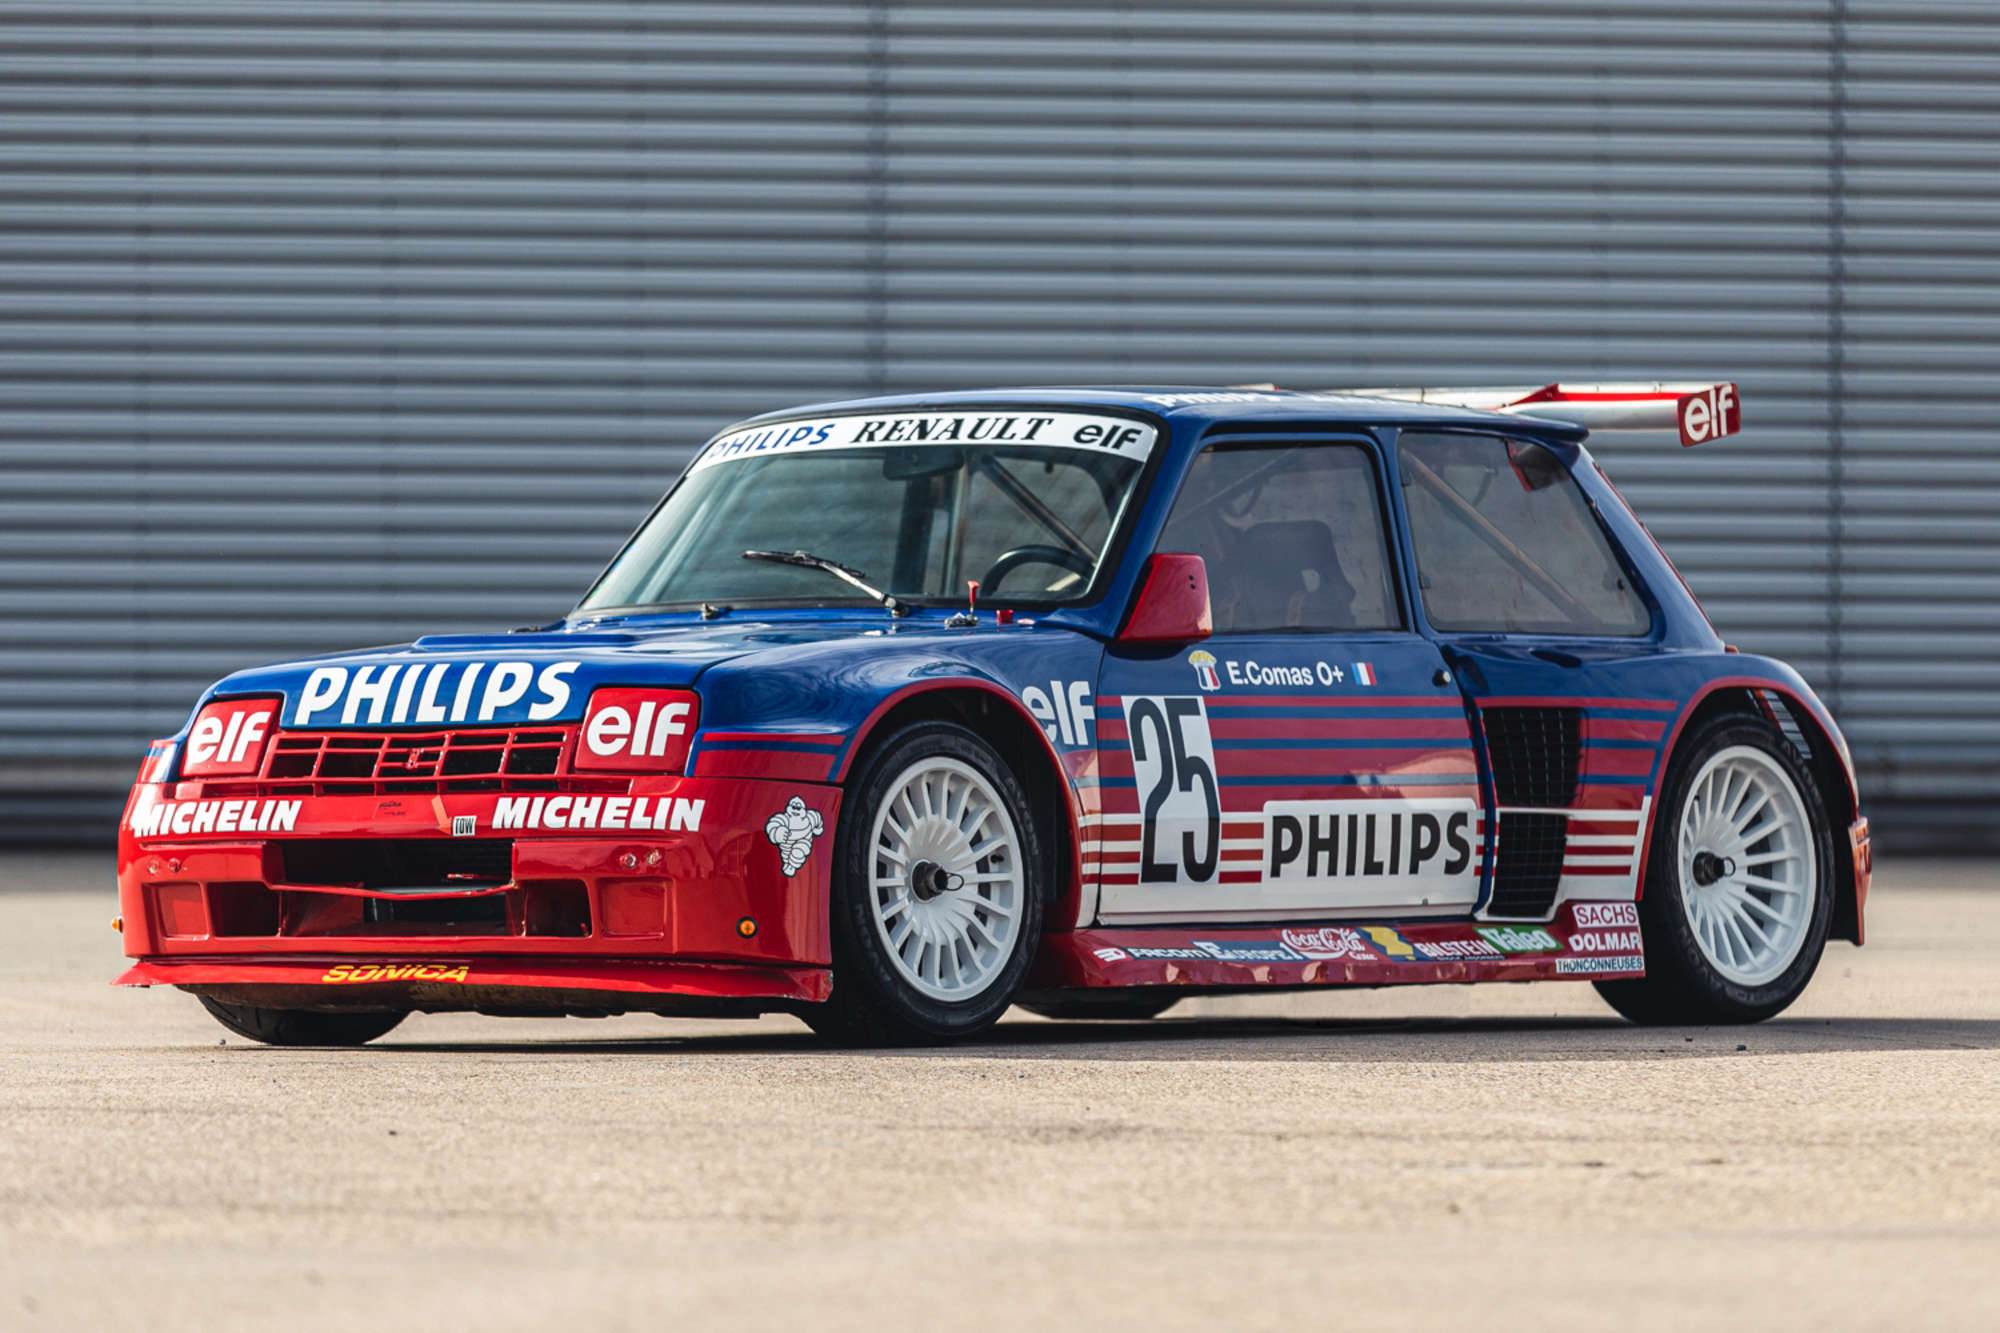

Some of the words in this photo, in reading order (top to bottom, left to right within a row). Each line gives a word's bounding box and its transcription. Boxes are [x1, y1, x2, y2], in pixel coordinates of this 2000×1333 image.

[1685, 384, 1733, 442] elf
[709, 423, 836, 459] PHILIPS
[851, 417, 1054, 443] RENAULT
[1073, 424, 1142, 451] elf
[1225, 660, 1314, 686] E.Comas
[294, 661, 582, 725] PHILIPS
[586, 700, 691, 757] elf
[1022, 679, 1095, 746] elf
[185, 711, 272, 765] elf
[1128, 697, 1221, 883] 25
[131, 799, 303, 837] MICHELIN
[455, 818, 474, 834] TOW
[491, 796, 706, 832] MICHELIN
[1270, 812, 1471, 878] PHILIPS
[1576, 905, 1637, 925] SACHS
[1414, 940, 1501, 958] BILSTEIN
[1477, 927, 1557, 951] Valeo
[1568, 932, 1641, 952] DOLMAR
[322, 964, 470, 983] SONICA
